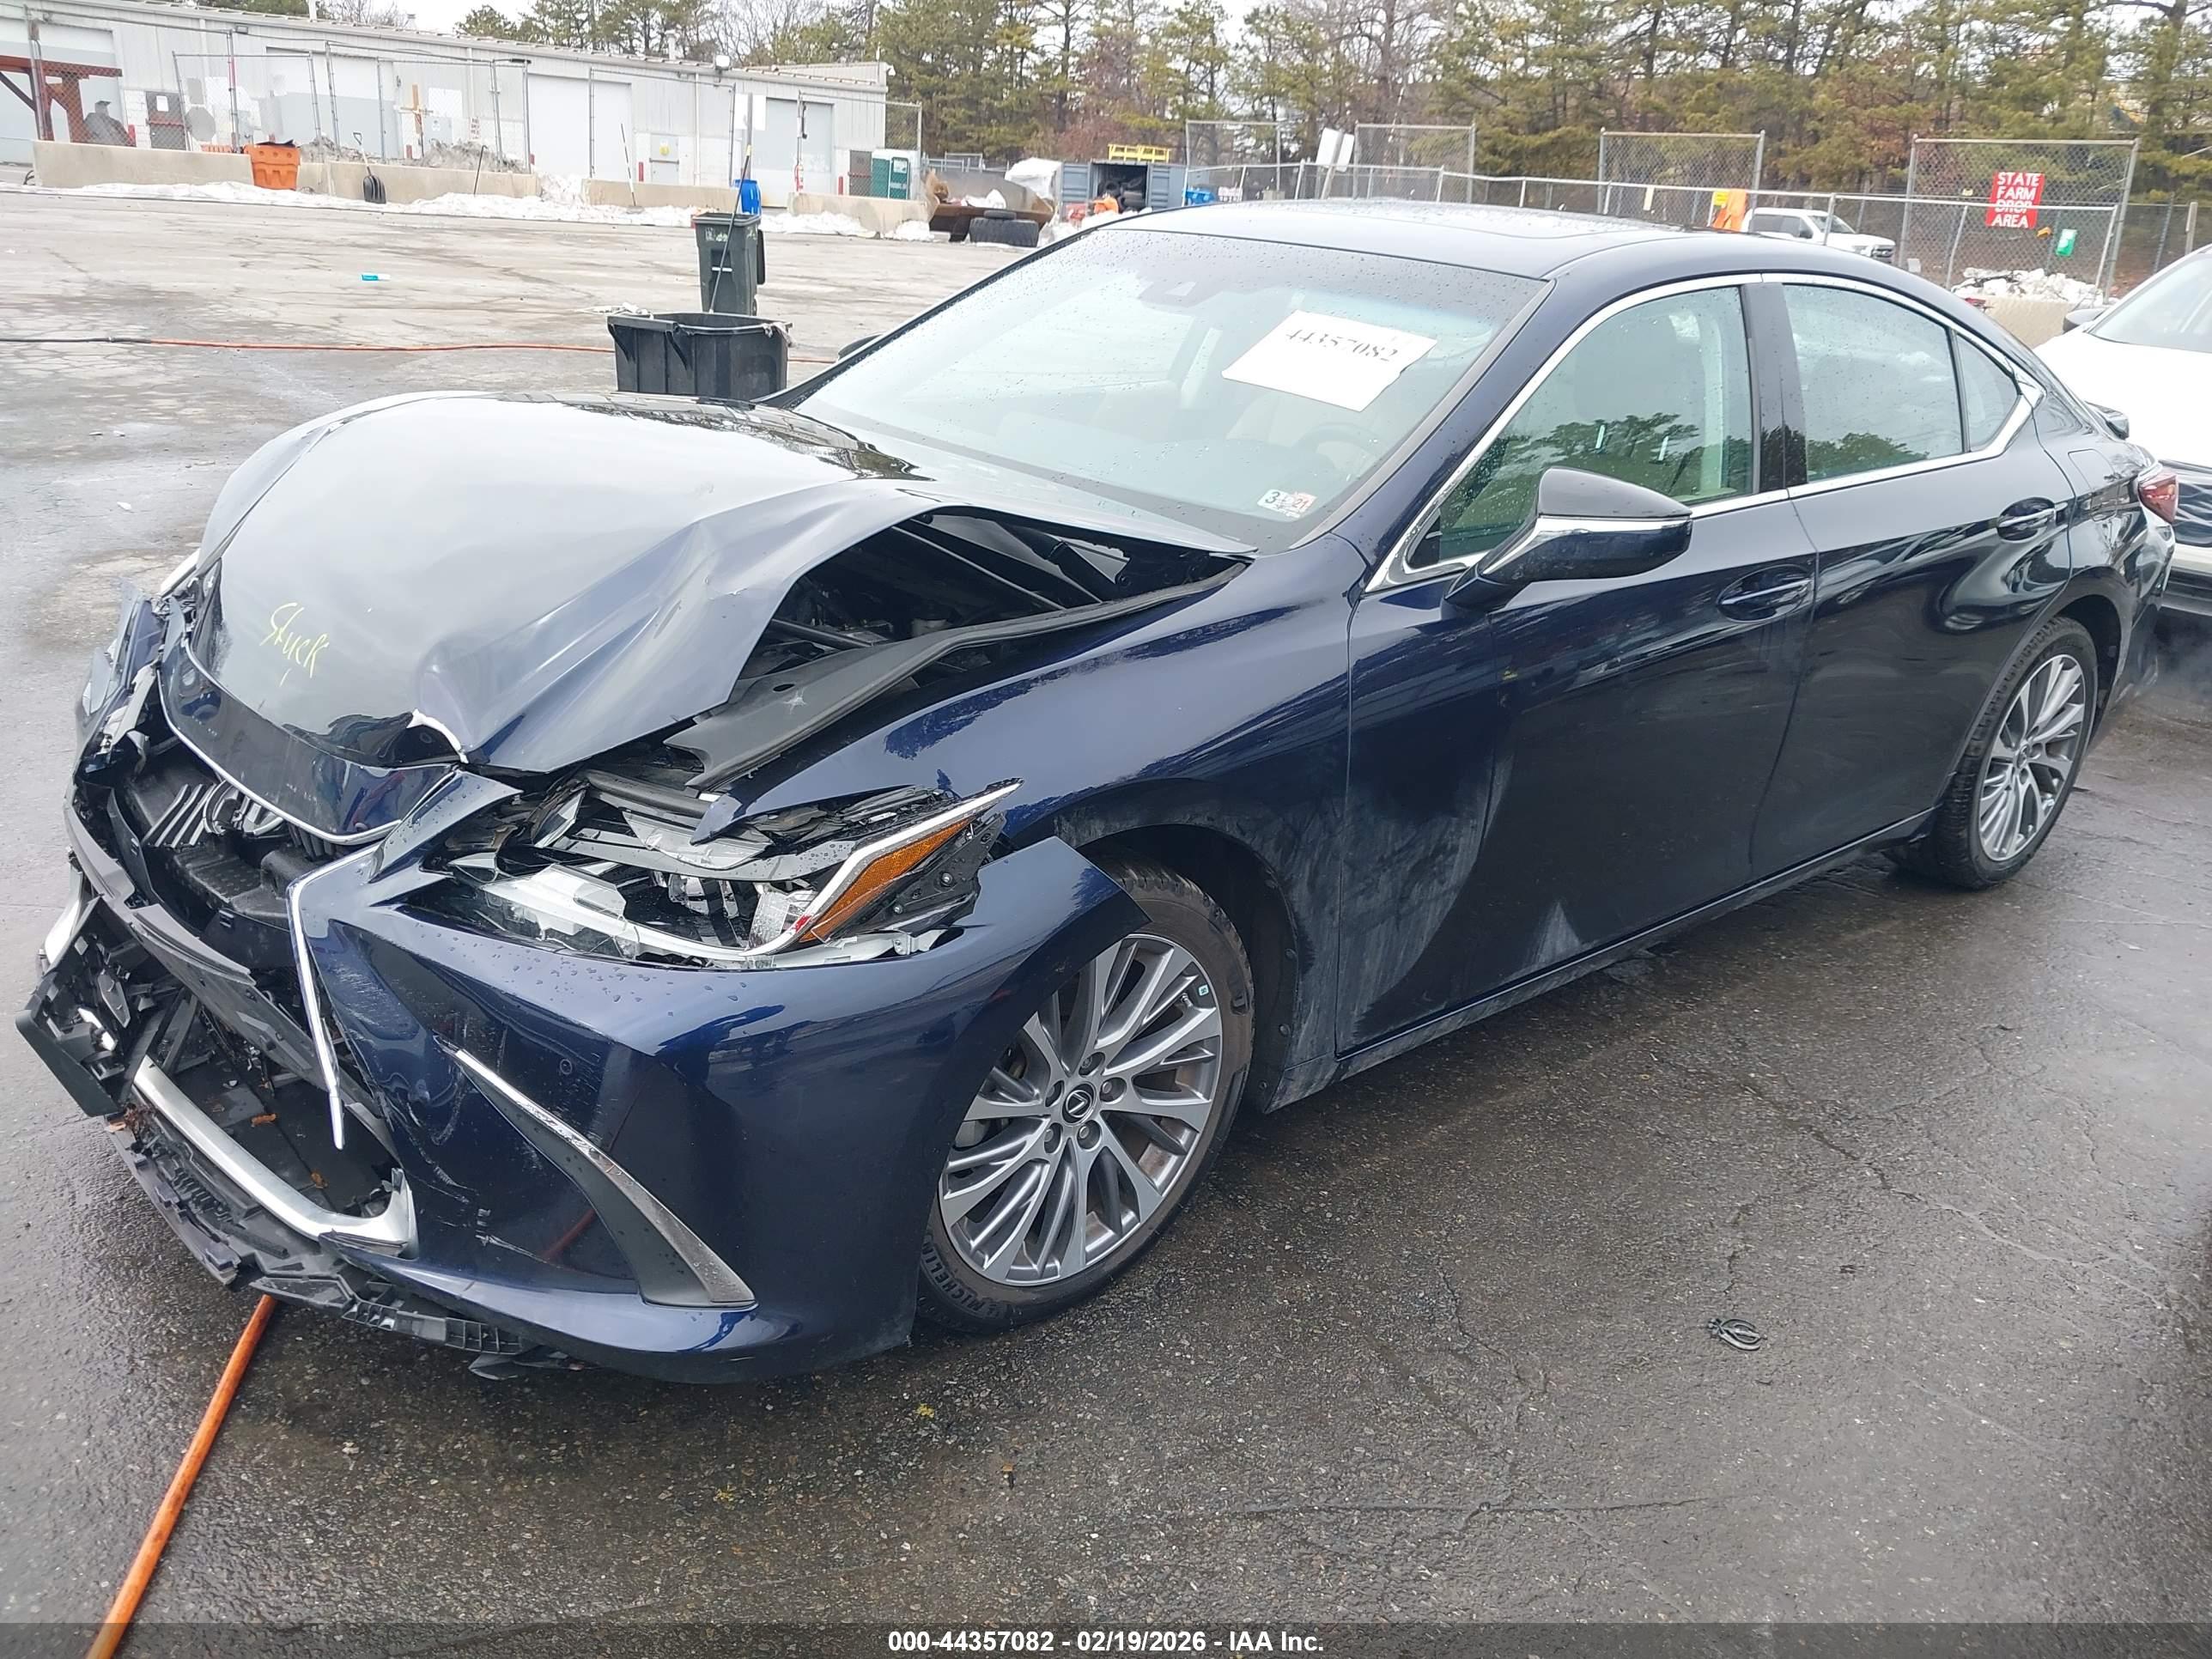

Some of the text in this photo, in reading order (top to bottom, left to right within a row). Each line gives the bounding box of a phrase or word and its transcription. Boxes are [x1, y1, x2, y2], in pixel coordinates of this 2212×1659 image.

[1996, 172, 2041, 187] STATE
[1996, 185, 2036, 200] FARM
[1991, 214, 2029, 228] AREA
[922, 1241, 986, 1312] MICHELIN
